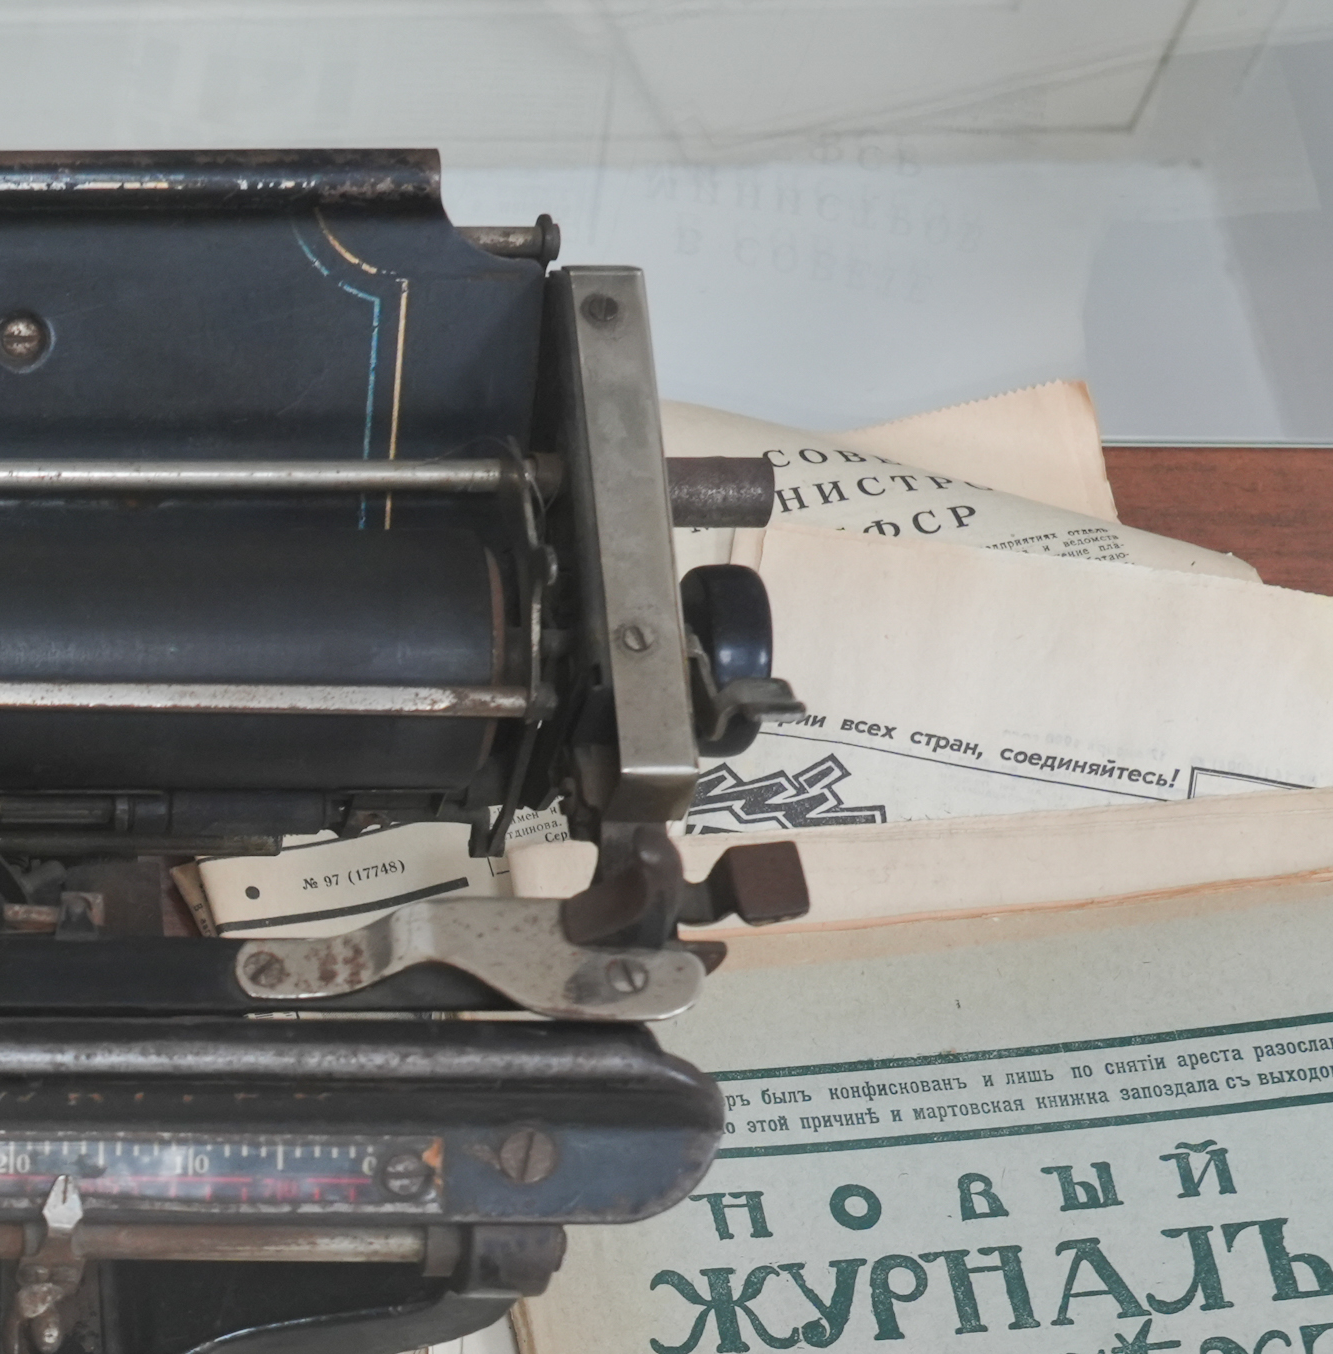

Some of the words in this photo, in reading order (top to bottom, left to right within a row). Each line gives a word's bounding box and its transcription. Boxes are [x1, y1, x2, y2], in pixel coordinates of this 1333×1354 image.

[840, 718, 897, 739] всех
[909, 729, 984, 760] стран,
[1000, 746, 1180, 790] соединяйтесь!
[323, 873, 340, 889] 97
[348, 859, 406, 886] (17748)
[746, 1115, 789, 1134] этой
[914, 1098, 1025, 1122] мартовская
[1036, 1089, 1110, 1110] книжка
[1119, 1079, 1219, 1102] запоздала
[1225, 1075, 1251, 1090] съ
[761, 1087, 812, 1105] былъ
[828, 1076, 968, 1101] конфискованъ
[1005, 1069, 1054, 1086] лишь
[1071, 1064, 1093, 1080] по
[1177, 1046, 1244, 1070] ареста
